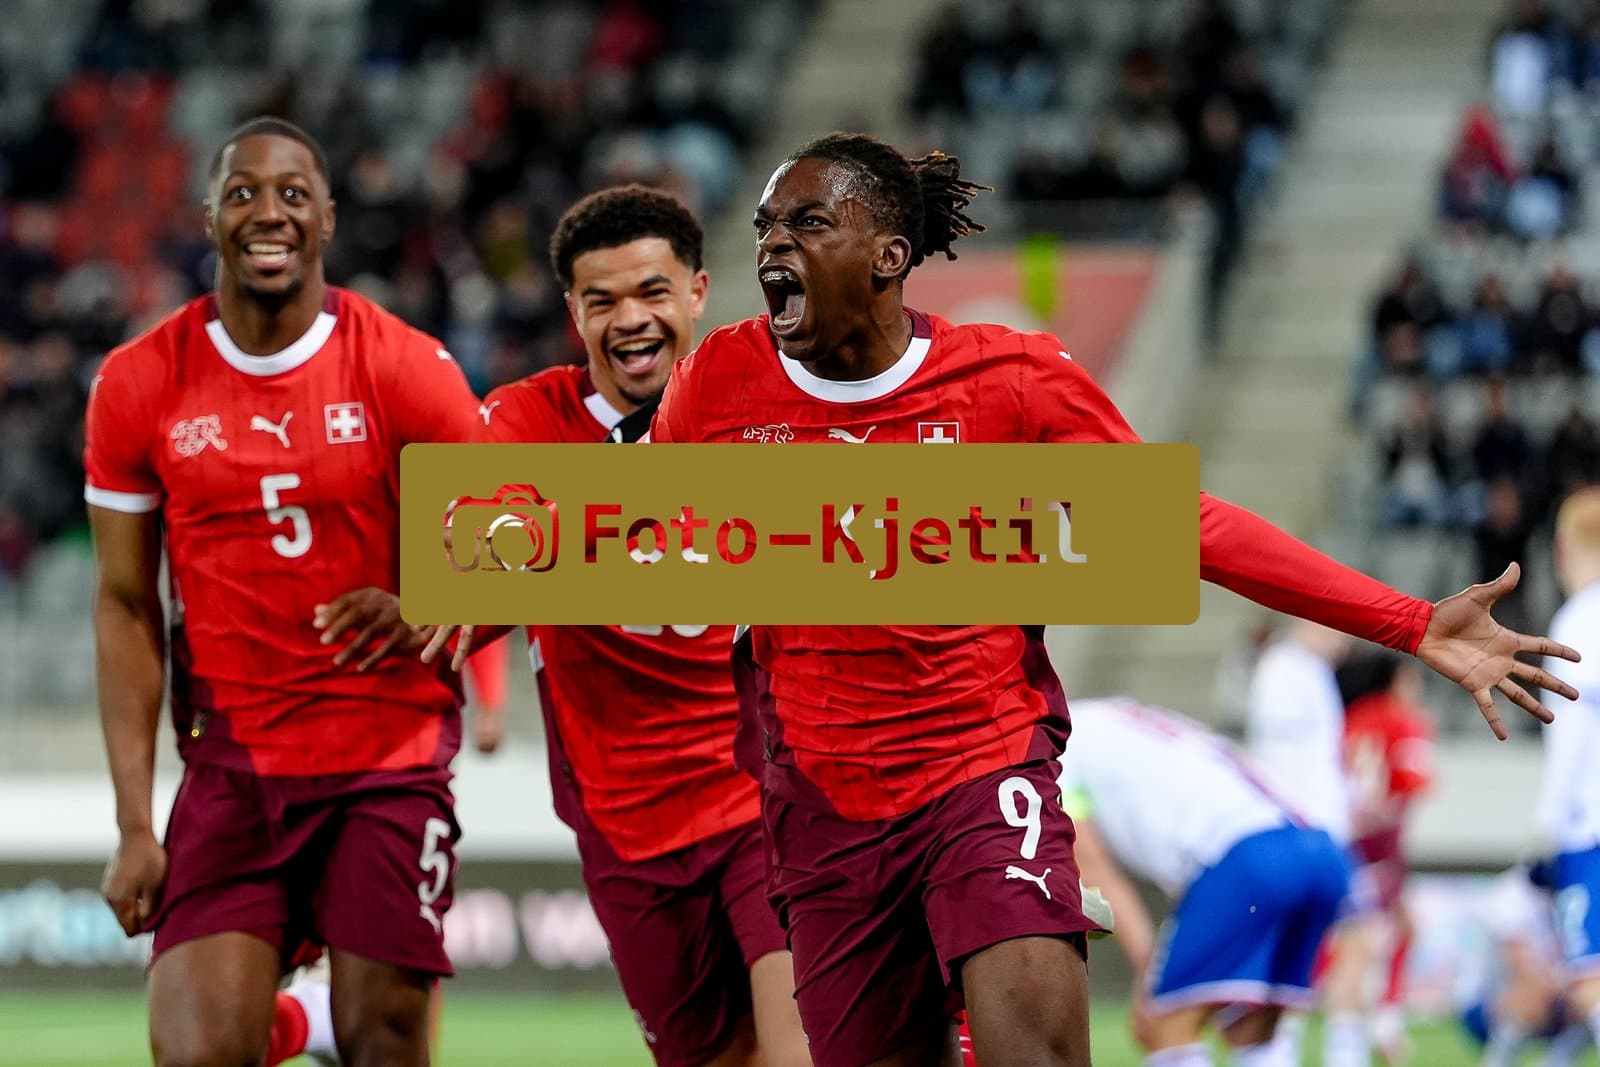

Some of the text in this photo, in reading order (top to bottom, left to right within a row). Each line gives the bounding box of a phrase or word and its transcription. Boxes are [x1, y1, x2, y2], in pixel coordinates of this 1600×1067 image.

[260, 473, 313, 558] 5
[998, 776, 1042, 860] 9
[418, 818, 450, 904] 5
